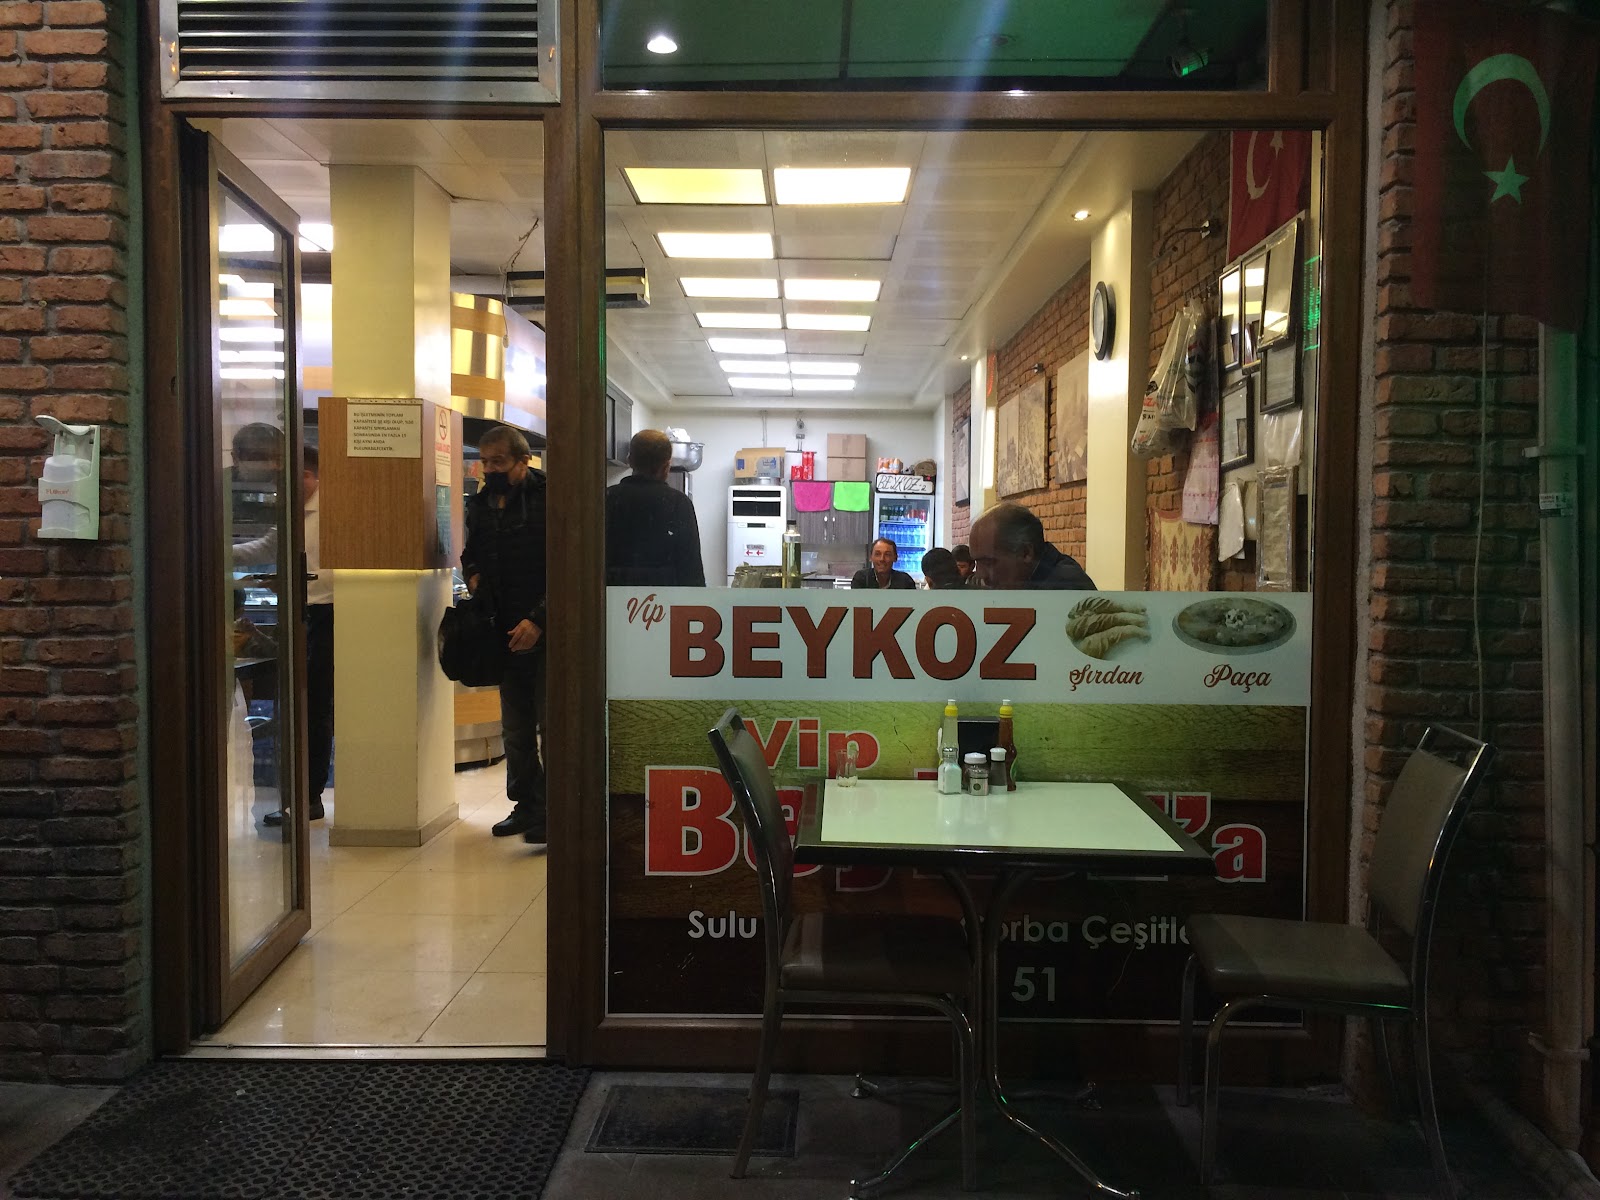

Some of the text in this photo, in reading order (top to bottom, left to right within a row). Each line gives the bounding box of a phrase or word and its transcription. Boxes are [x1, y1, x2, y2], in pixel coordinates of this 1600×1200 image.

[627, 593, 666, 631] Vip
[669, 604, 1037, 681] BEYKOZ
[1069, 663, 1272, 693] Şırdan Paça
[741, 716, 880, 779] Vip
[687, 910, 757, 939] Sulu
[1010, 965, 1057, 1002] 51
